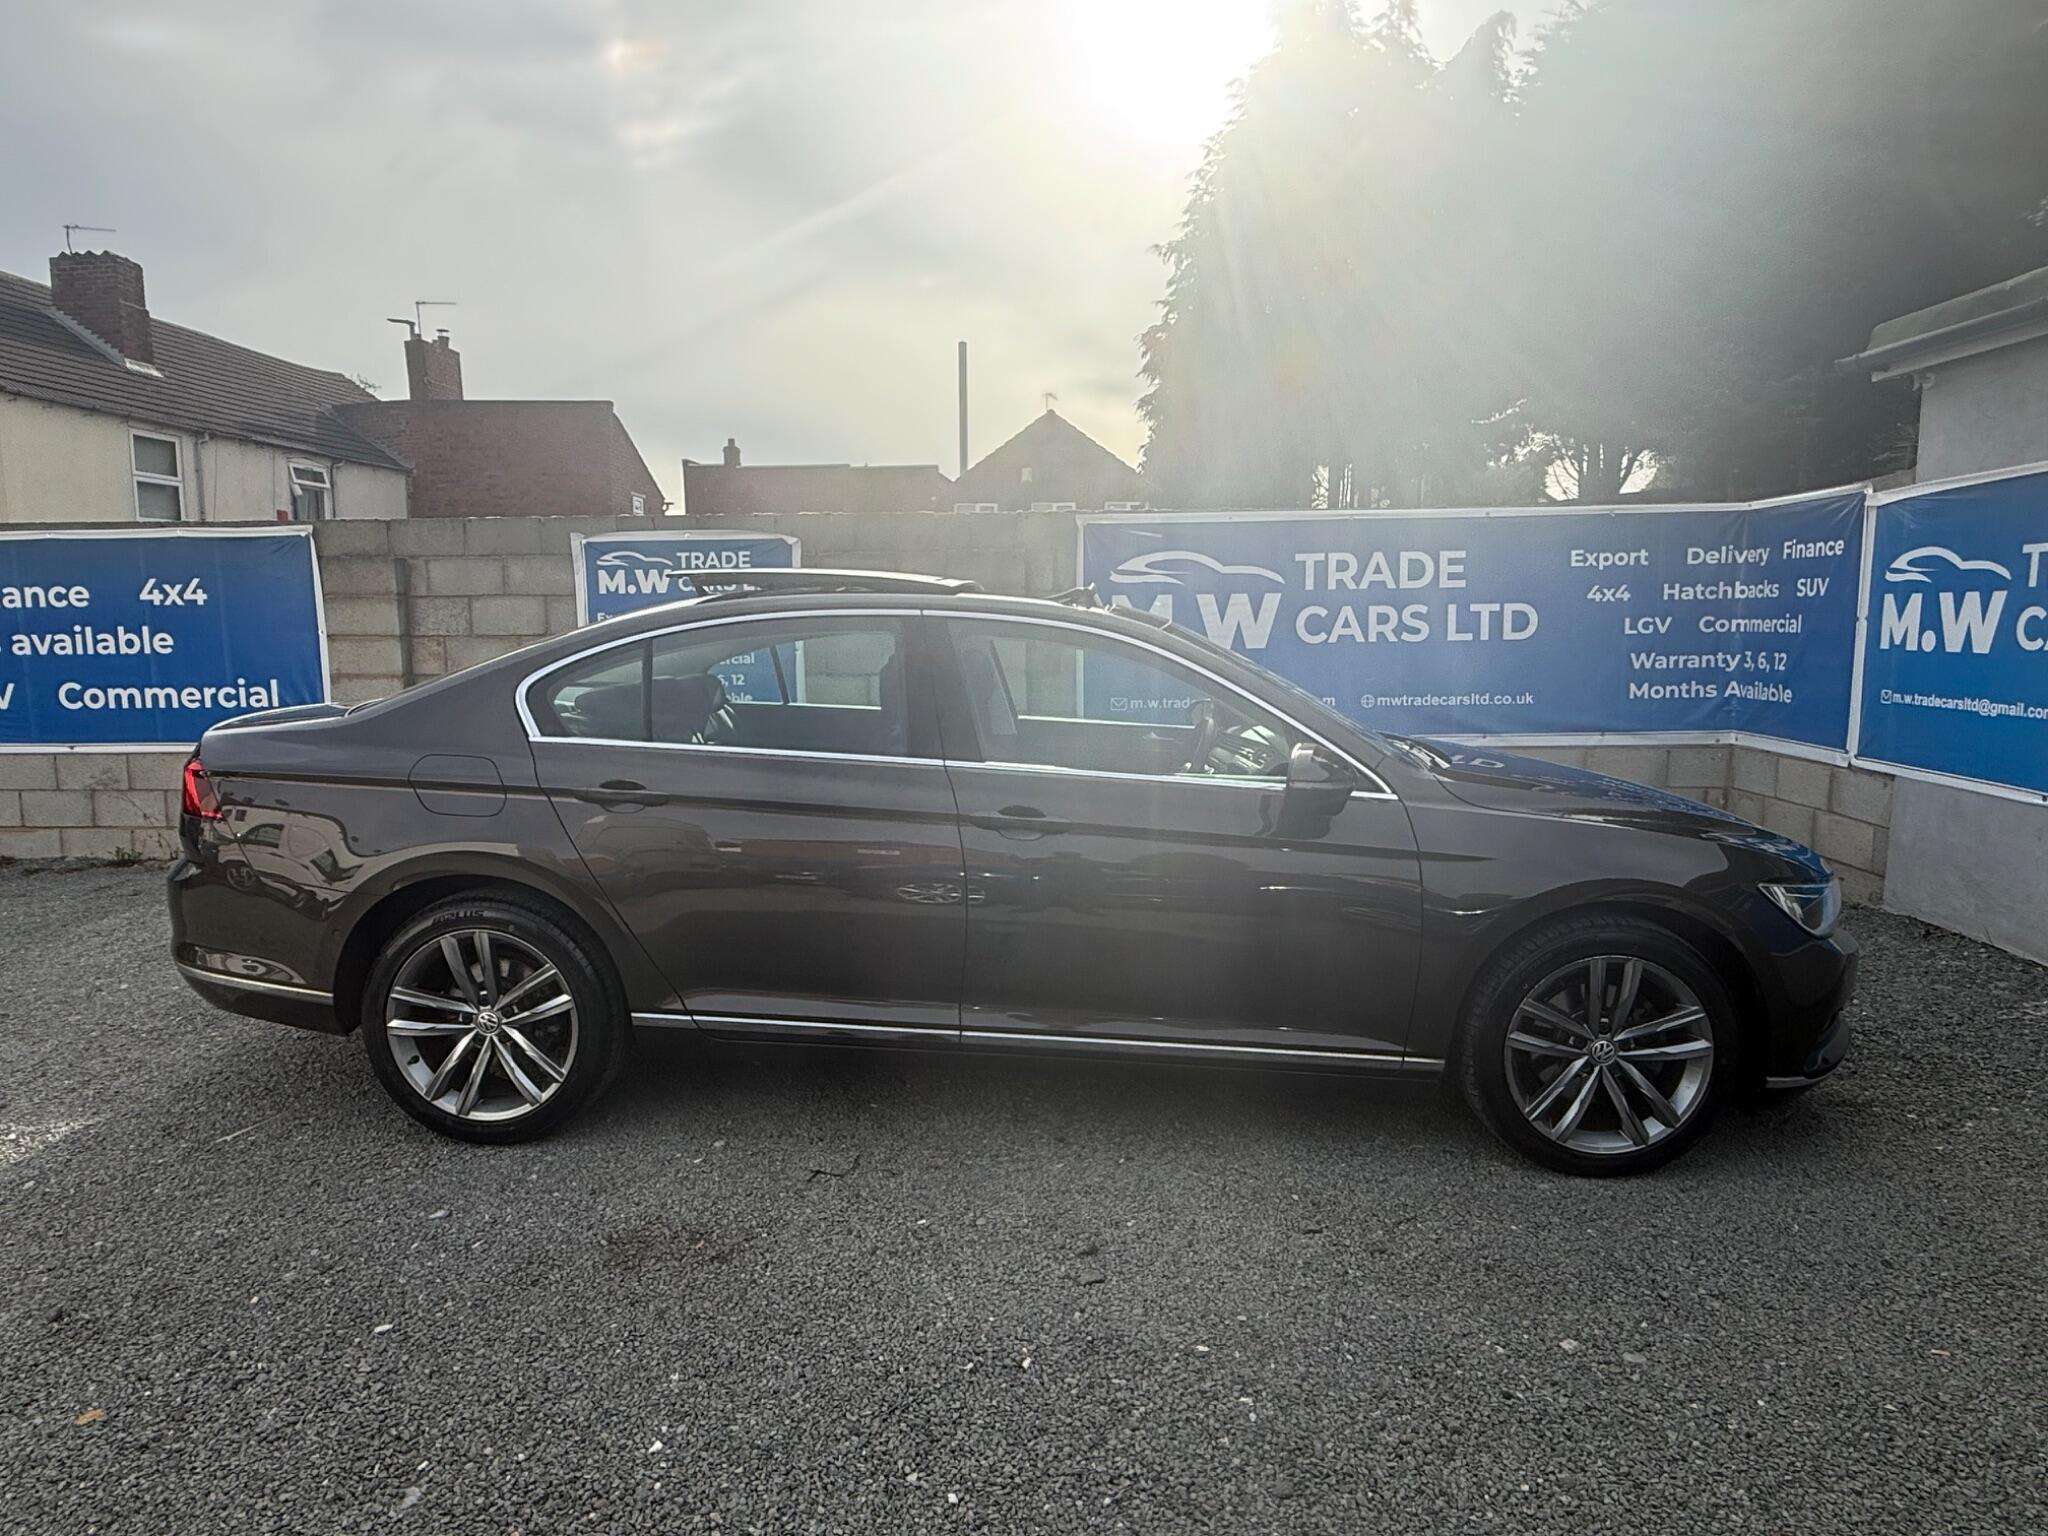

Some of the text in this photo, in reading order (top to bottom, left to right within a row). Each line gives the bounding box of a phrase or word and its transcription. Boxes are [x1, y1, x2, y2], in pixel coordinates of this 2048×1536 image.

[676, 551, 751, 569] TRADE
[1570, 538, 1845, 570] Export Delivery Finance
[597, 569, 672, 595] M.W
[1295, 551, 1467, 591] TRADE
[0, 577, 208, 608] ance 4x4
[1586, 577, 1830, 602] 4x4 Hatchbacks SUV
[1295, 602, 1539, 644] CARS LTD
[1624, 613, 1803, 635] LGV Commercial
[1880, 590, 2008, 654] M.W
[11, 625, 175, 656] available
[1630, 652, 1741, 673] Warranty
[1757, 652, 1770, 673] 6,
[1773, 652, 1788, 671] 12
[58, 678, 280, 710] Commercial
[1377, 692, 1535, 706] mwtradecarsltd.co.uk
[1628, 680, 1793, 704] Months Available
